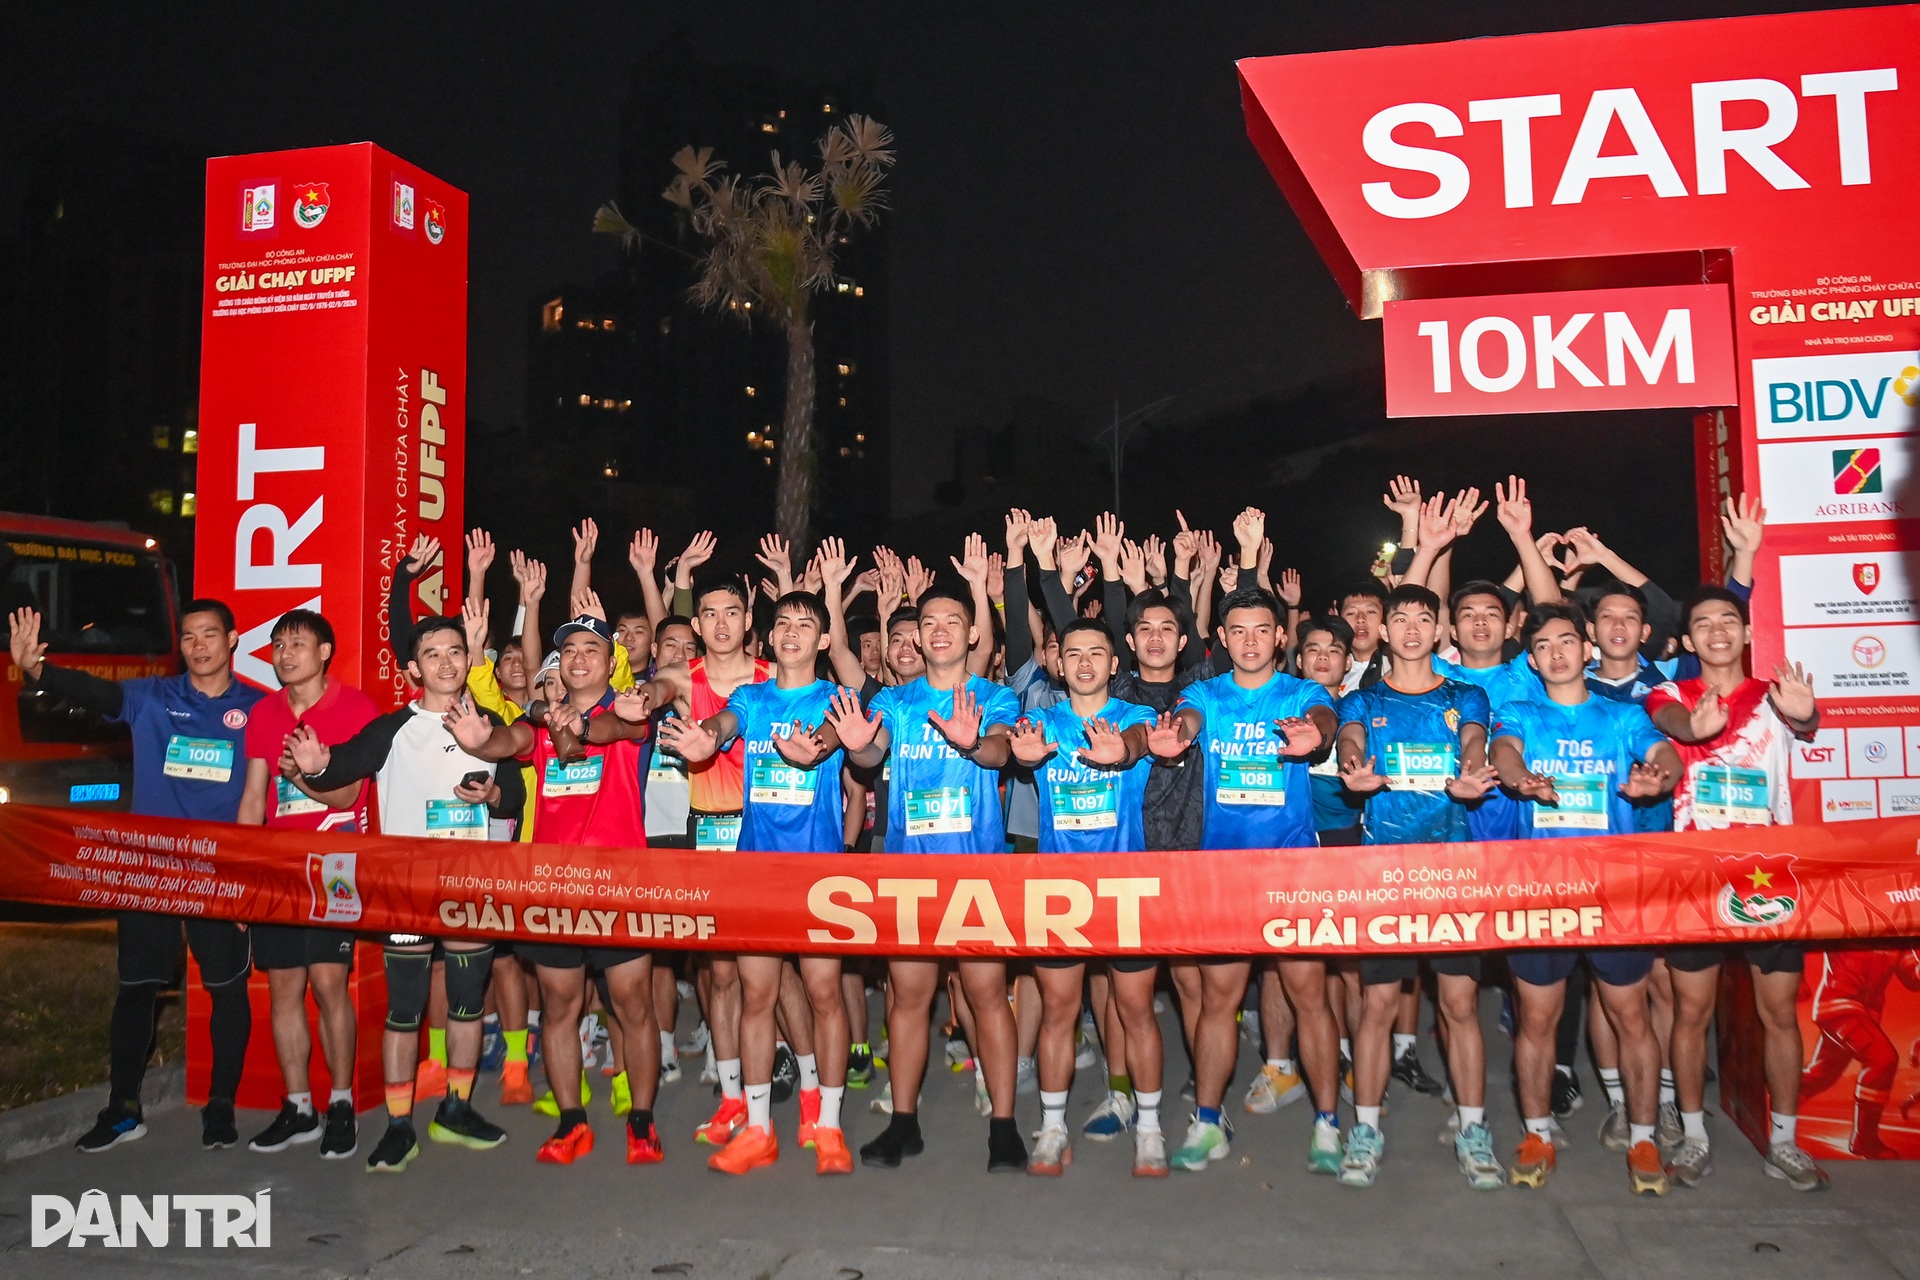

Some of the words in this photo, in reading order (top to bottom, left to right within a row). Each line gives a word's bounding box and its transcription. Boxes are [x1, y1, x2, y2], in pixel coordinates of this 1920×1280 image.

[1361, 67, 1898, 219] START
[276, 250, 294, 258] CÔNG
[216, 270, 255, 292] GIẢI
[258, 270, 307, 290] CHẠY
[311, 266, 356, 284] UFPF
[1817, 277, 1830, 286] BỘ
[1832, 276, 1857, 285] CÔNG
[1859, 275, 1871, 283] AN
[1862, 284, 1887, 293] CHÁY
[1750, 299, 1806, 325] GIẢI
[1810, 300, 1878, 323] CHẠY
[1418, 308, 1695, 392] 10KM
[396, 367, 409, 428] CHÁY
[1769, 377, 1892, 424] BIDV
[418, 368, 447, 521] UFPF
[395, 433, 408, 498] CHỮA
[1816, 501, 1905, 516] AGRIBANK
[380, 539, 392, 569] AN
[378, 575, 392, 642] CÔNG
[377, 647, 391, 680] BỘ
[770, 723, 795, 740] T0
[1234, 722, 1266, 739] T06
[189, 748, 220, 762] 1001
[900, 744, 932, 759] RUN
[1210, 739, 1244, 756] RUN
[1556, 739, 1593, 757] T06
[1801, 747, 1835, 763] VST
[1405, 755, 1442, 769] 1092
[1531, 760, 1568, 773] RUN
[1573, 761, 1616, 774] TEAM
[565, 766, 597, 779] 1025
[770, 770, 806, 784] 1060
[1048, 768, 1079, 783] RUN
[1240, 773, 1272, 786] 1081
[1720, 785, 1754, 802] 1015
[1071, 795, 1105, 810] 1097
[121, 832, 146, 848] CHÀO
[192, 836, 217, 856] NIỆM
[76, 846, 93, 860] 50
[94, 845, 117, 863] NĂM
[534, 863, 552, 879] BỘ
[555, 863, 591, 879] CÔNG
[594, 869, 611, 880] AN
[1382, 867, 1404, 884] BỘ
[1407, 867, 1453, 884] CÔNG
[1456, 868, 1477, 881] AN
[103, 869, 122, 888] HỌC
[124, 871, 158, 890] PHÒNG
[159, 873, 188, 893] CHÁY
[189, 877, 216, 896] CHỮA
[218, 881, 245, 899] CHÁY
[439, 875, 493, 890] TRƯỜNG
[496, 878, 517, 893] ĐẠI
[520, 880, 547, 895] HỌC
[550, 880, 594, 897] PHÒNG
[598, 884, 632, 898] CHÁY
[635, 885, 672, 900] CHỮA
[675, 887, 710, 901] CHÁY
[1267, 888, 1333, 904] TRƯỜNG
[1337, 889, 1362, 905] ĐẠI
[1366, 887, 1399, 904] HỌC
[1403, 885, 1460, 900] PHÒNG
[1461, 884, 1504, 899] CHÁY
[1507, 881, 1552, 898] CHỮA
[1555, 881, 1599, 895] CHÁY
[439, 894, 516, 932] GIẢI
[626, 911, 717, 940] UFPF
[806, 875, 1161, 949] START
[1262, 908, 1358, 948] GIẢI
[1366, 912, 1486, 946] CHẠY
[1494, 906, 1603, 941] UFPF
